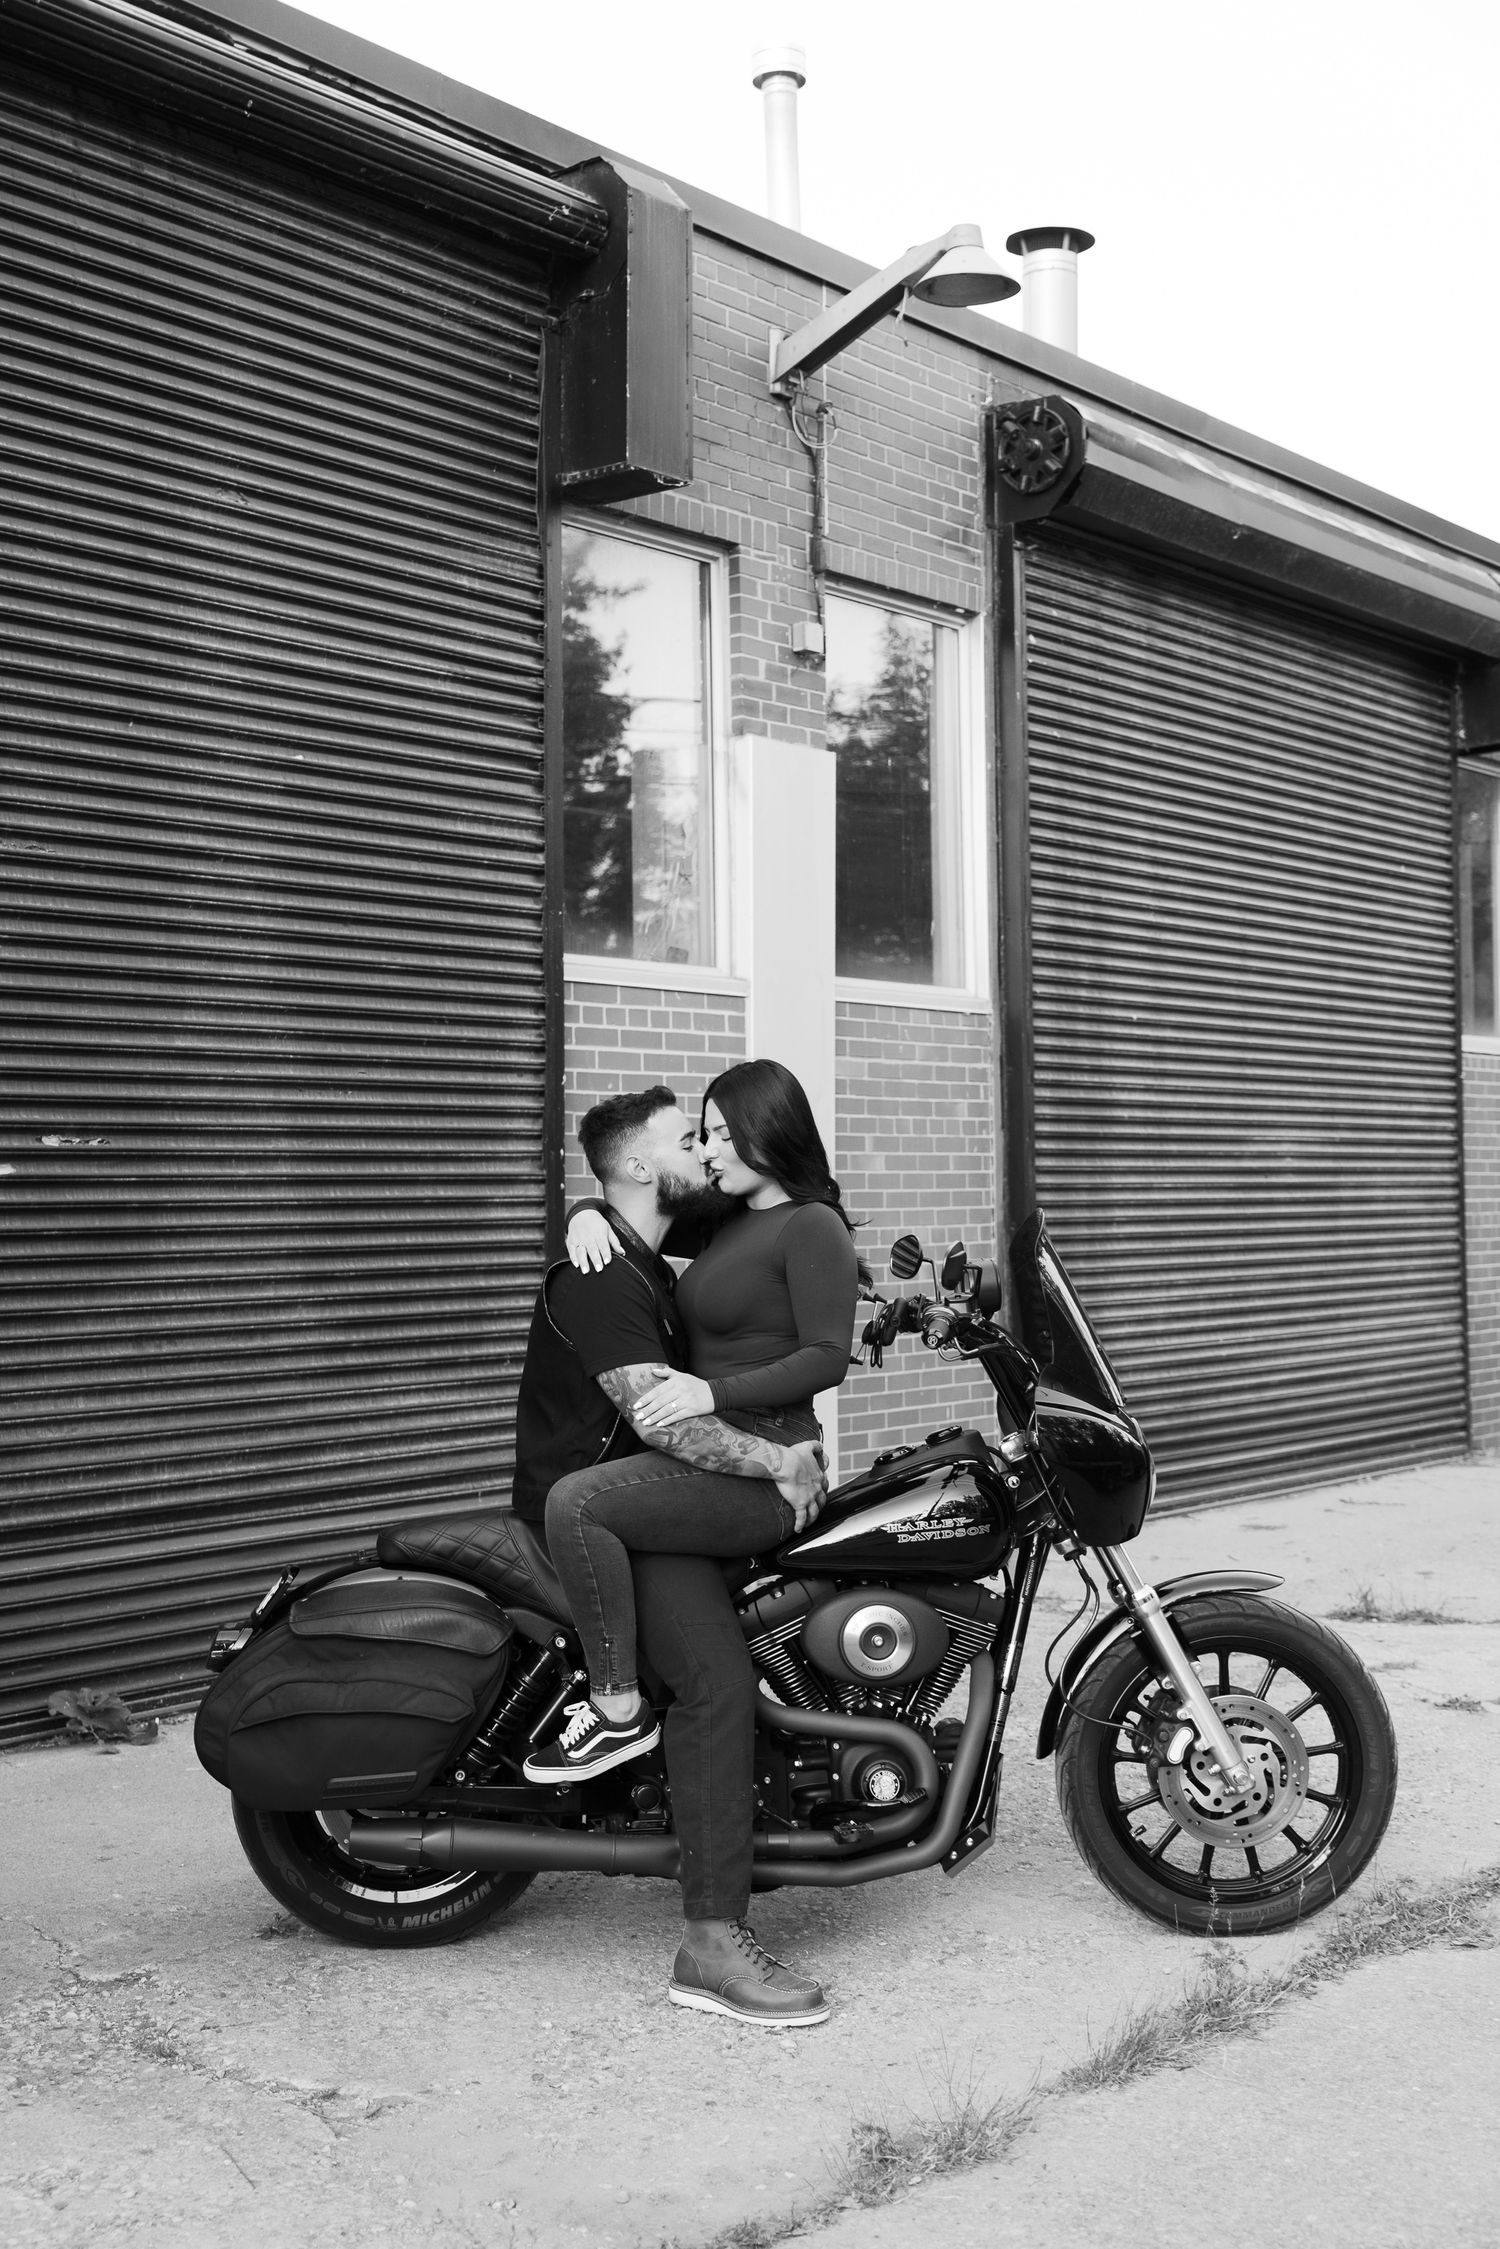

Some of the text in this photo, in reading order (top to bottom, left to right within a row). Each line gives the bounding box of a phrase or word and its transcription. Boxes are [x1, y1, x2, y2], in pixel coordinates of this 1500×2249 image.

[880, 1517, 974, 1534] HARLEY
[897, 1524, 991, 1543] DAVIDSON
[401, 1879, 493, 1929] MICHELIN
